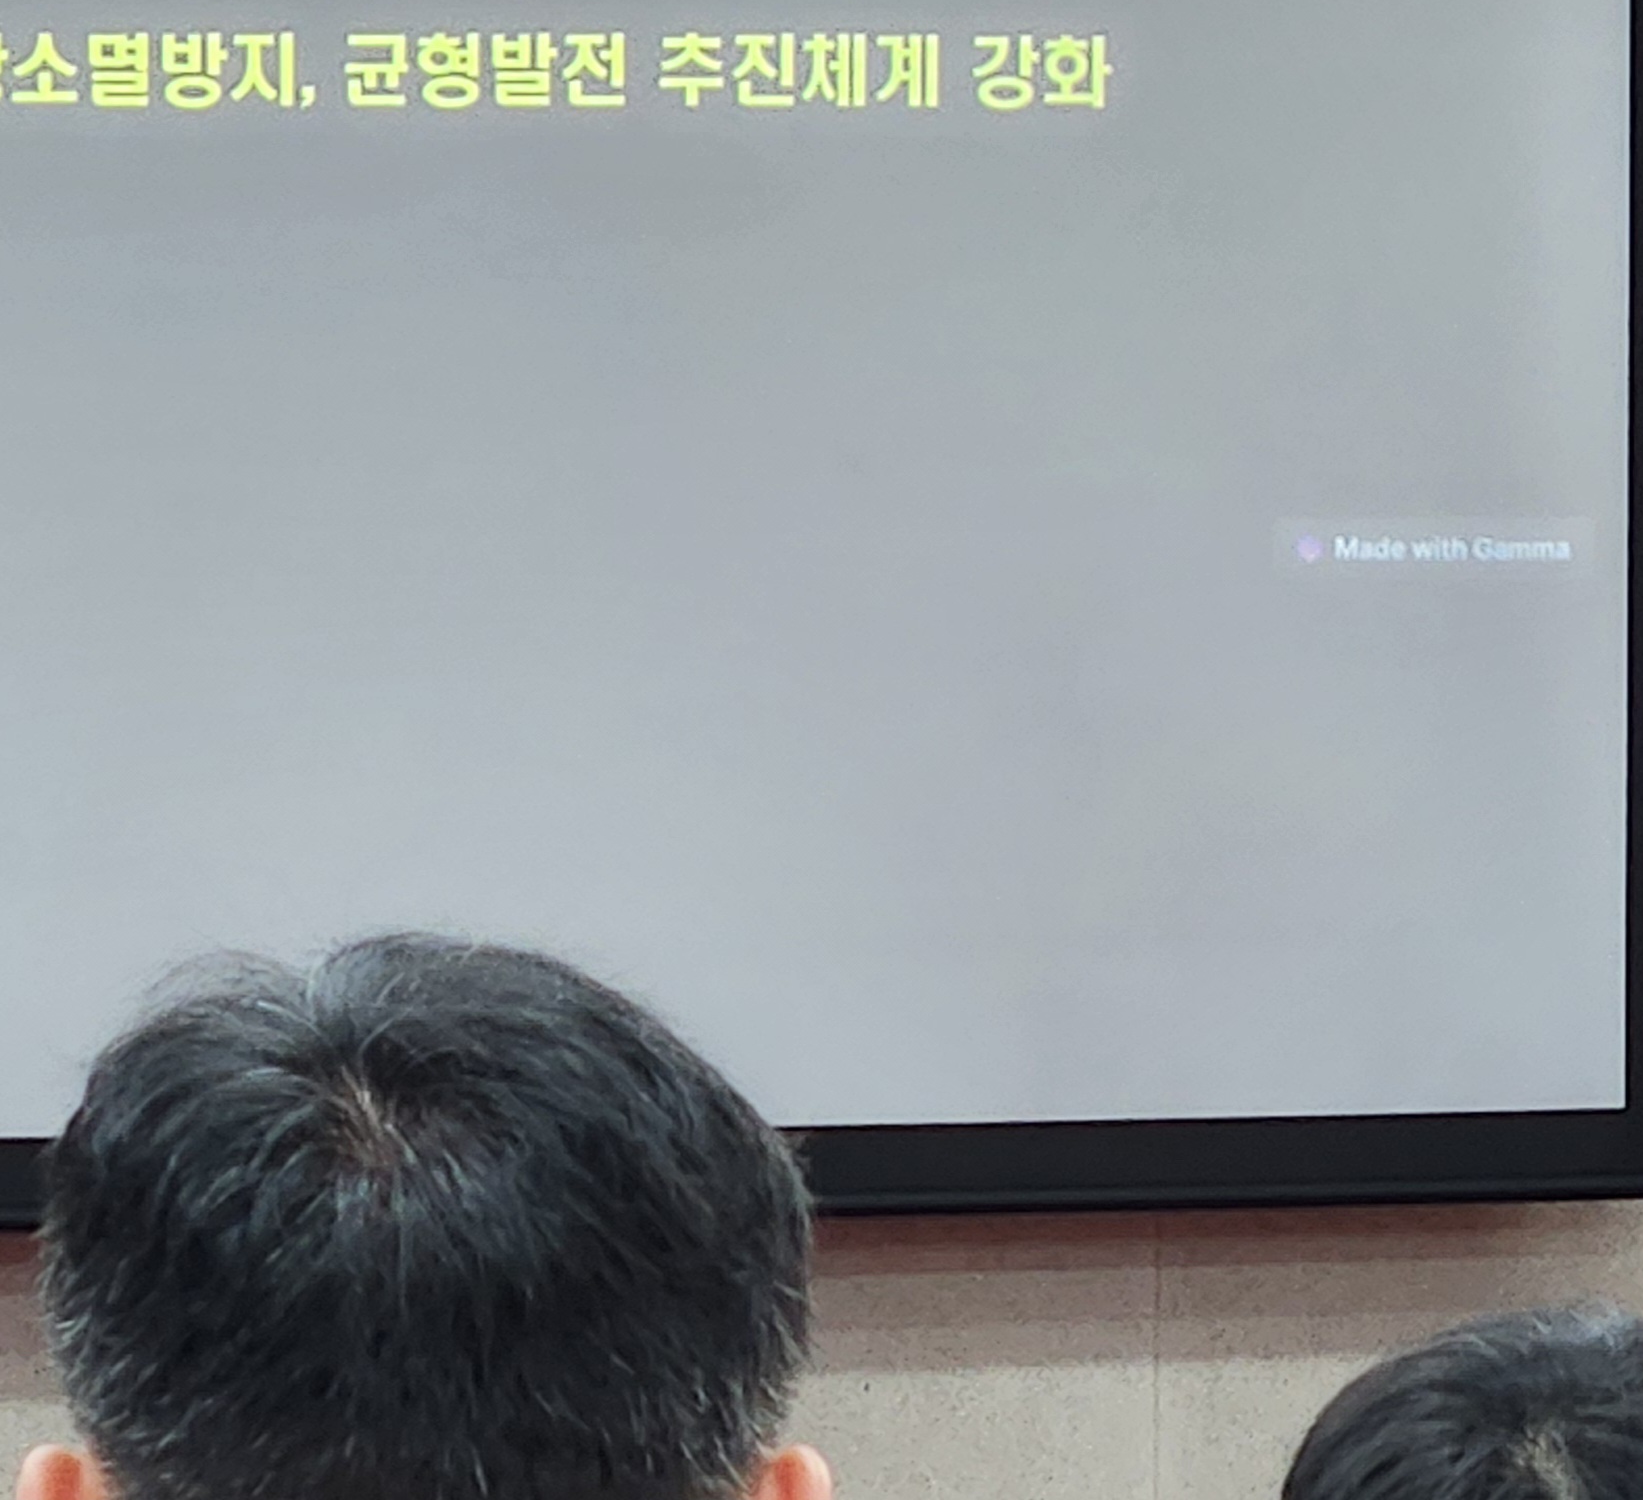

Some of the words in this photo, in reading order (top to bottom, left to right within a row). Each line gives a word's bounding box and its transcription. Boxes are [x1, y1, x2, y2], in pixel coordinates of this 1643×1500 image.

[0, 31, 316, 109] 소멸방지,
[343, 31, 627, 109] 균형발전
[658, 31, 940, 108] 추진체계
[971, 33, 1114, 109] 강화
[1333, 535, 1405, 561] Made
[1411, 535, 1467, 561] with
[1472, 535, 1571, 561] Gamma
